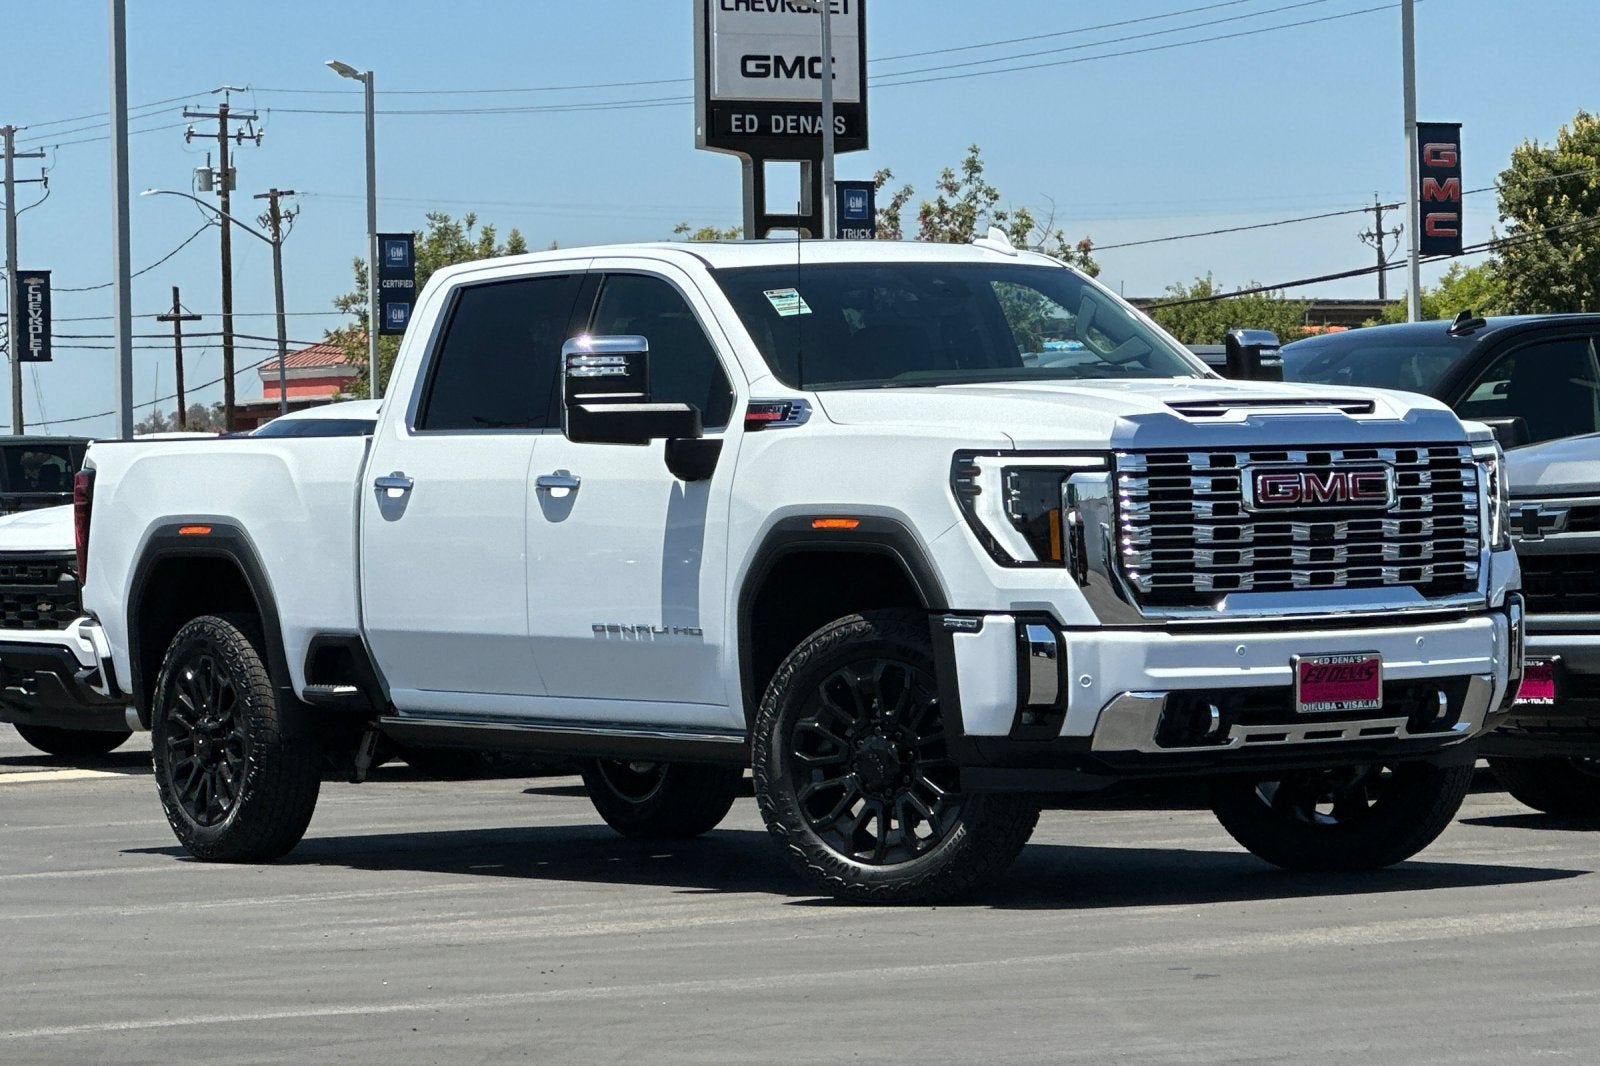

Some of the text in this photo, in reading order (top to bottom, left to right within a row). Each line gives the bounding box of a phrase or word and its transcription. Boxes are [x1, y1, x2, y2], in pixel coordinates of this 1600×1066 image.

[740, 55, 836, 79] GMC
[731, 114, 846, 135] ED DENAS
[1423, 143, 1460, 237] GMC
[849, 196, 863, 209] GM
[842, 228, 872, 239] TRUCK
[391, 247, 403, 258] GM
[382, 279, 414, 288] CERTIFIED
[392, 309, 404, 320] GM
[27, 285, 43, 357] CHEVROLET
[1257, 471, 1388, 504] GMC
[1318, 657, 1330, 665] ED
[1343, 700, 1378, 709] VISALIA
